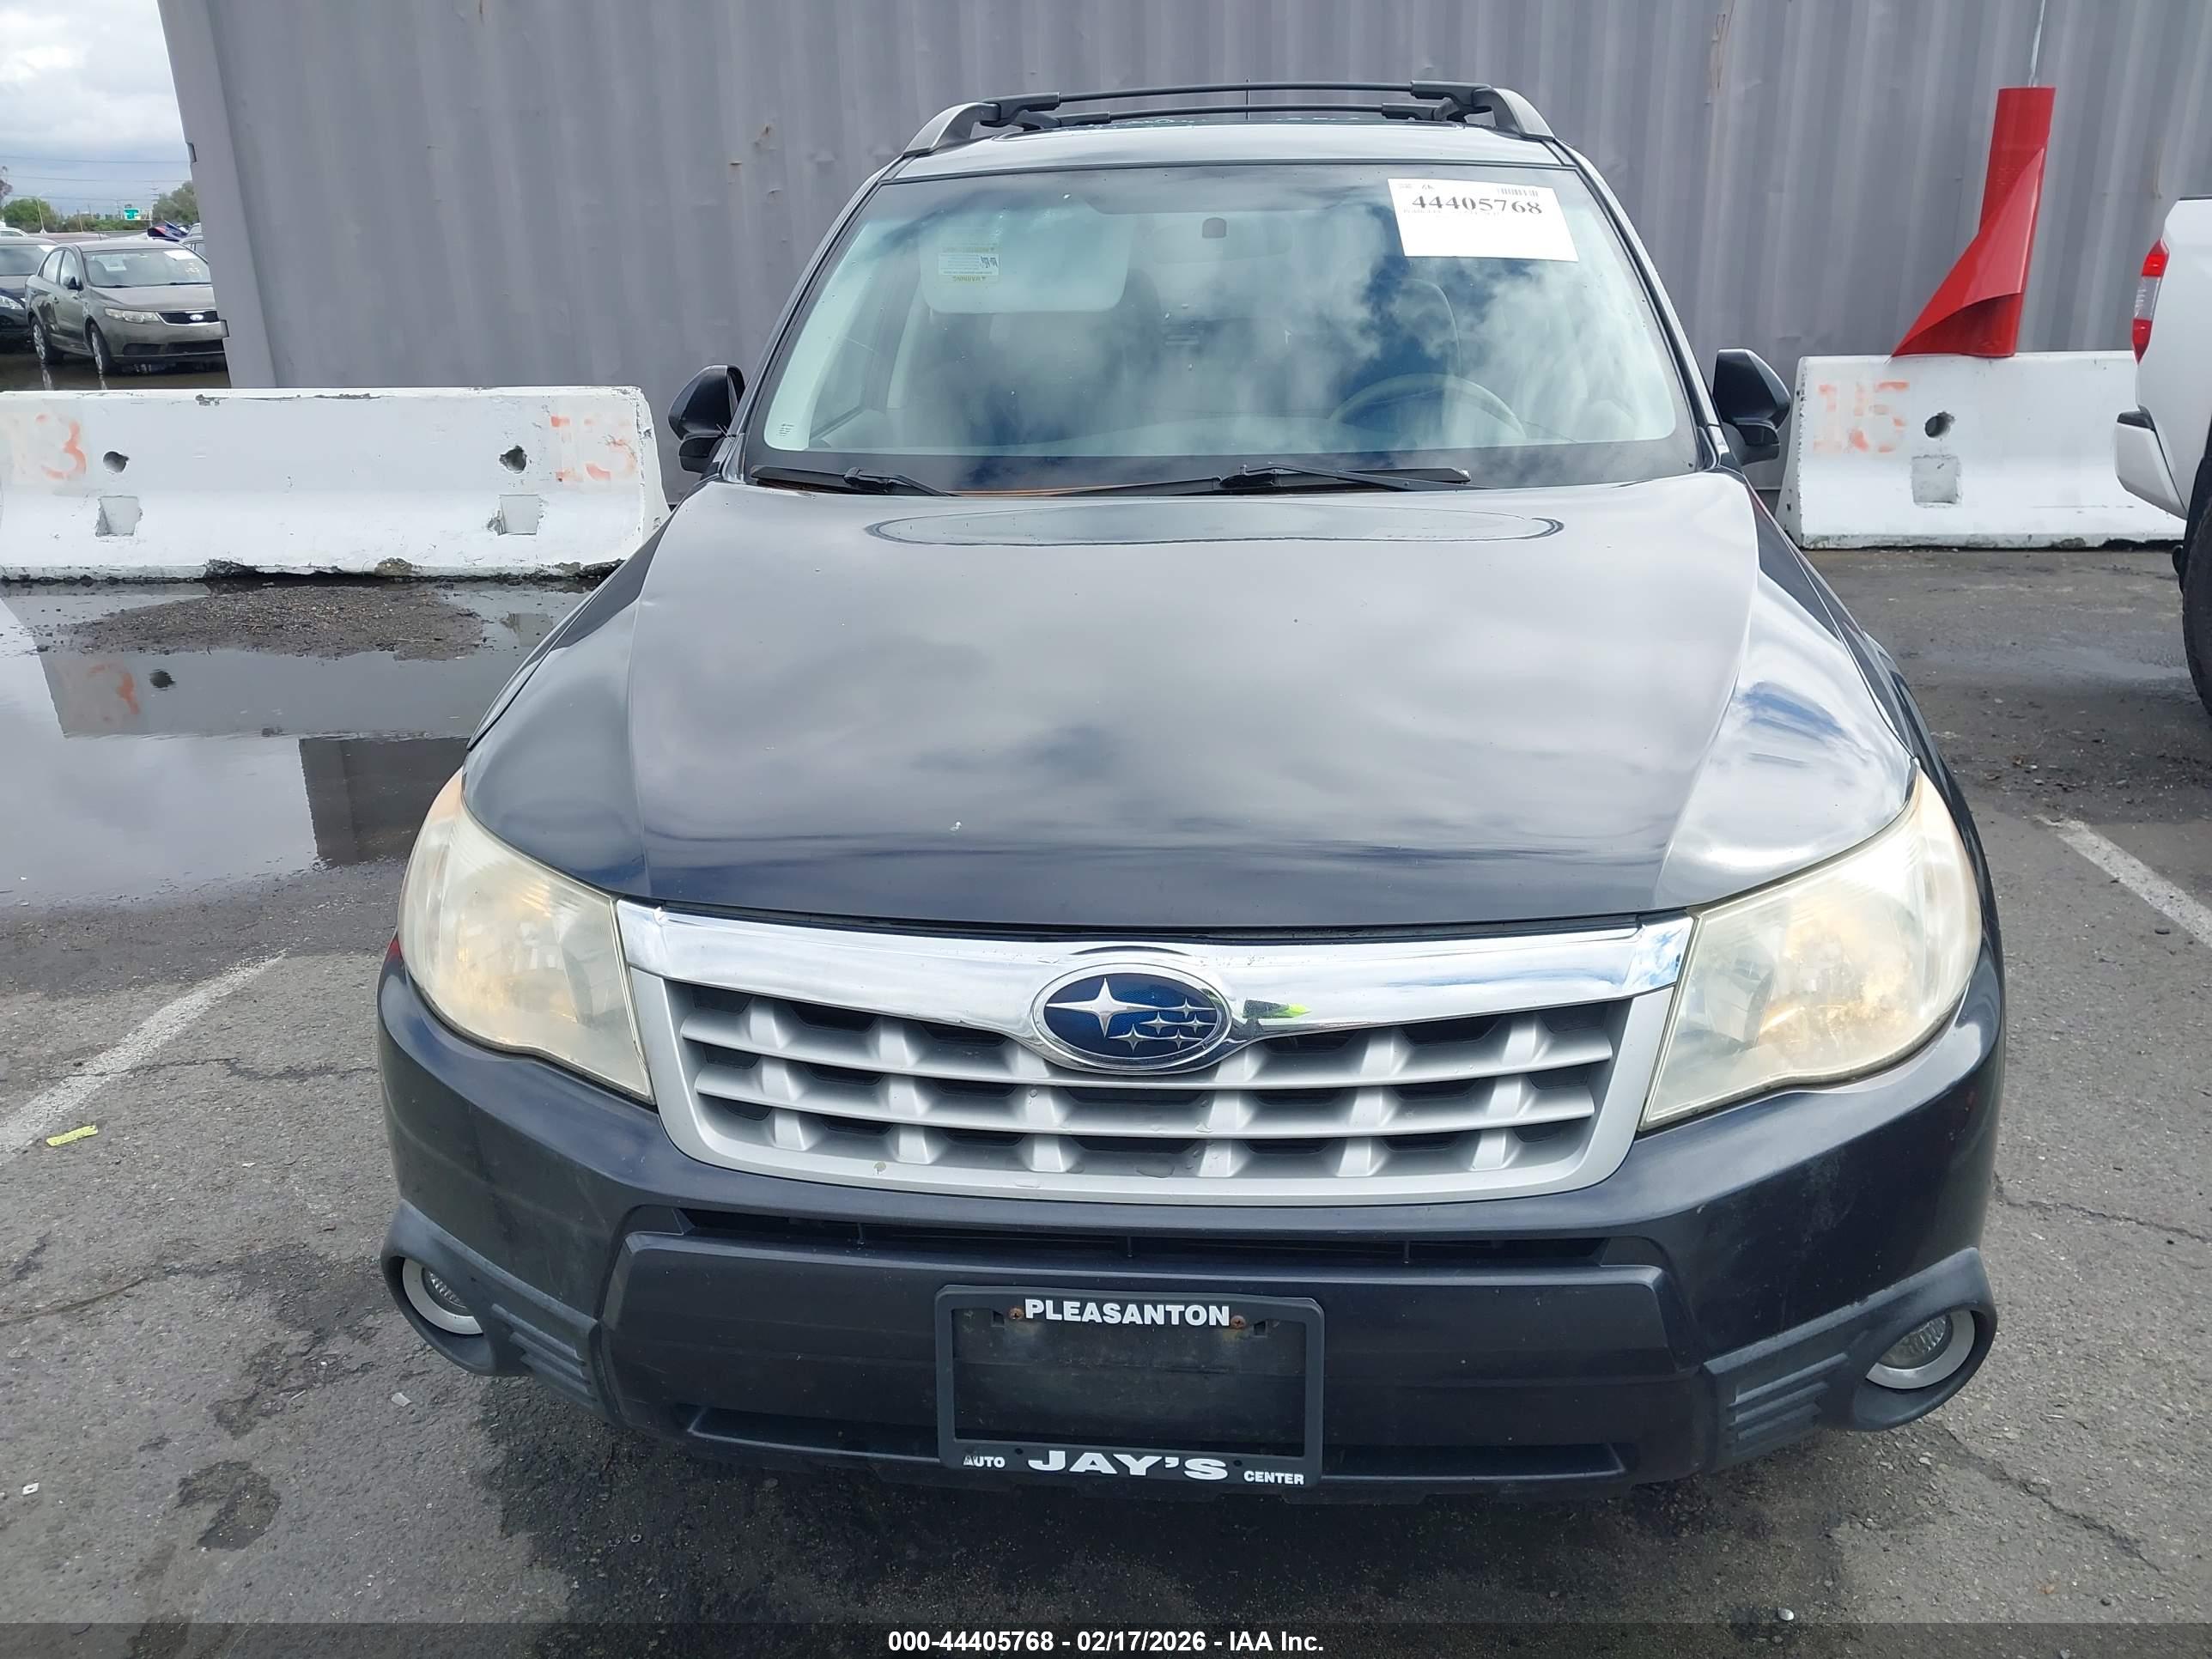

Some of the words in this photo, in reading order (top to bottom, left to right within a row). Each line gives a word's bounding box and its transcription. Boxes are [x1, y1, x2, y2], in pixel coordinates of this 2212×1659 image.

[1412, 195, 1543, 215] 44405768
[1024, 1298, 1230, 1327] PLEASANTON
[963, 1455, 1006, 1468] AUTO
[1028, 1449, 1229, 1480] JAY'S
[1243, 1470, 1304, 1486] CENTER
